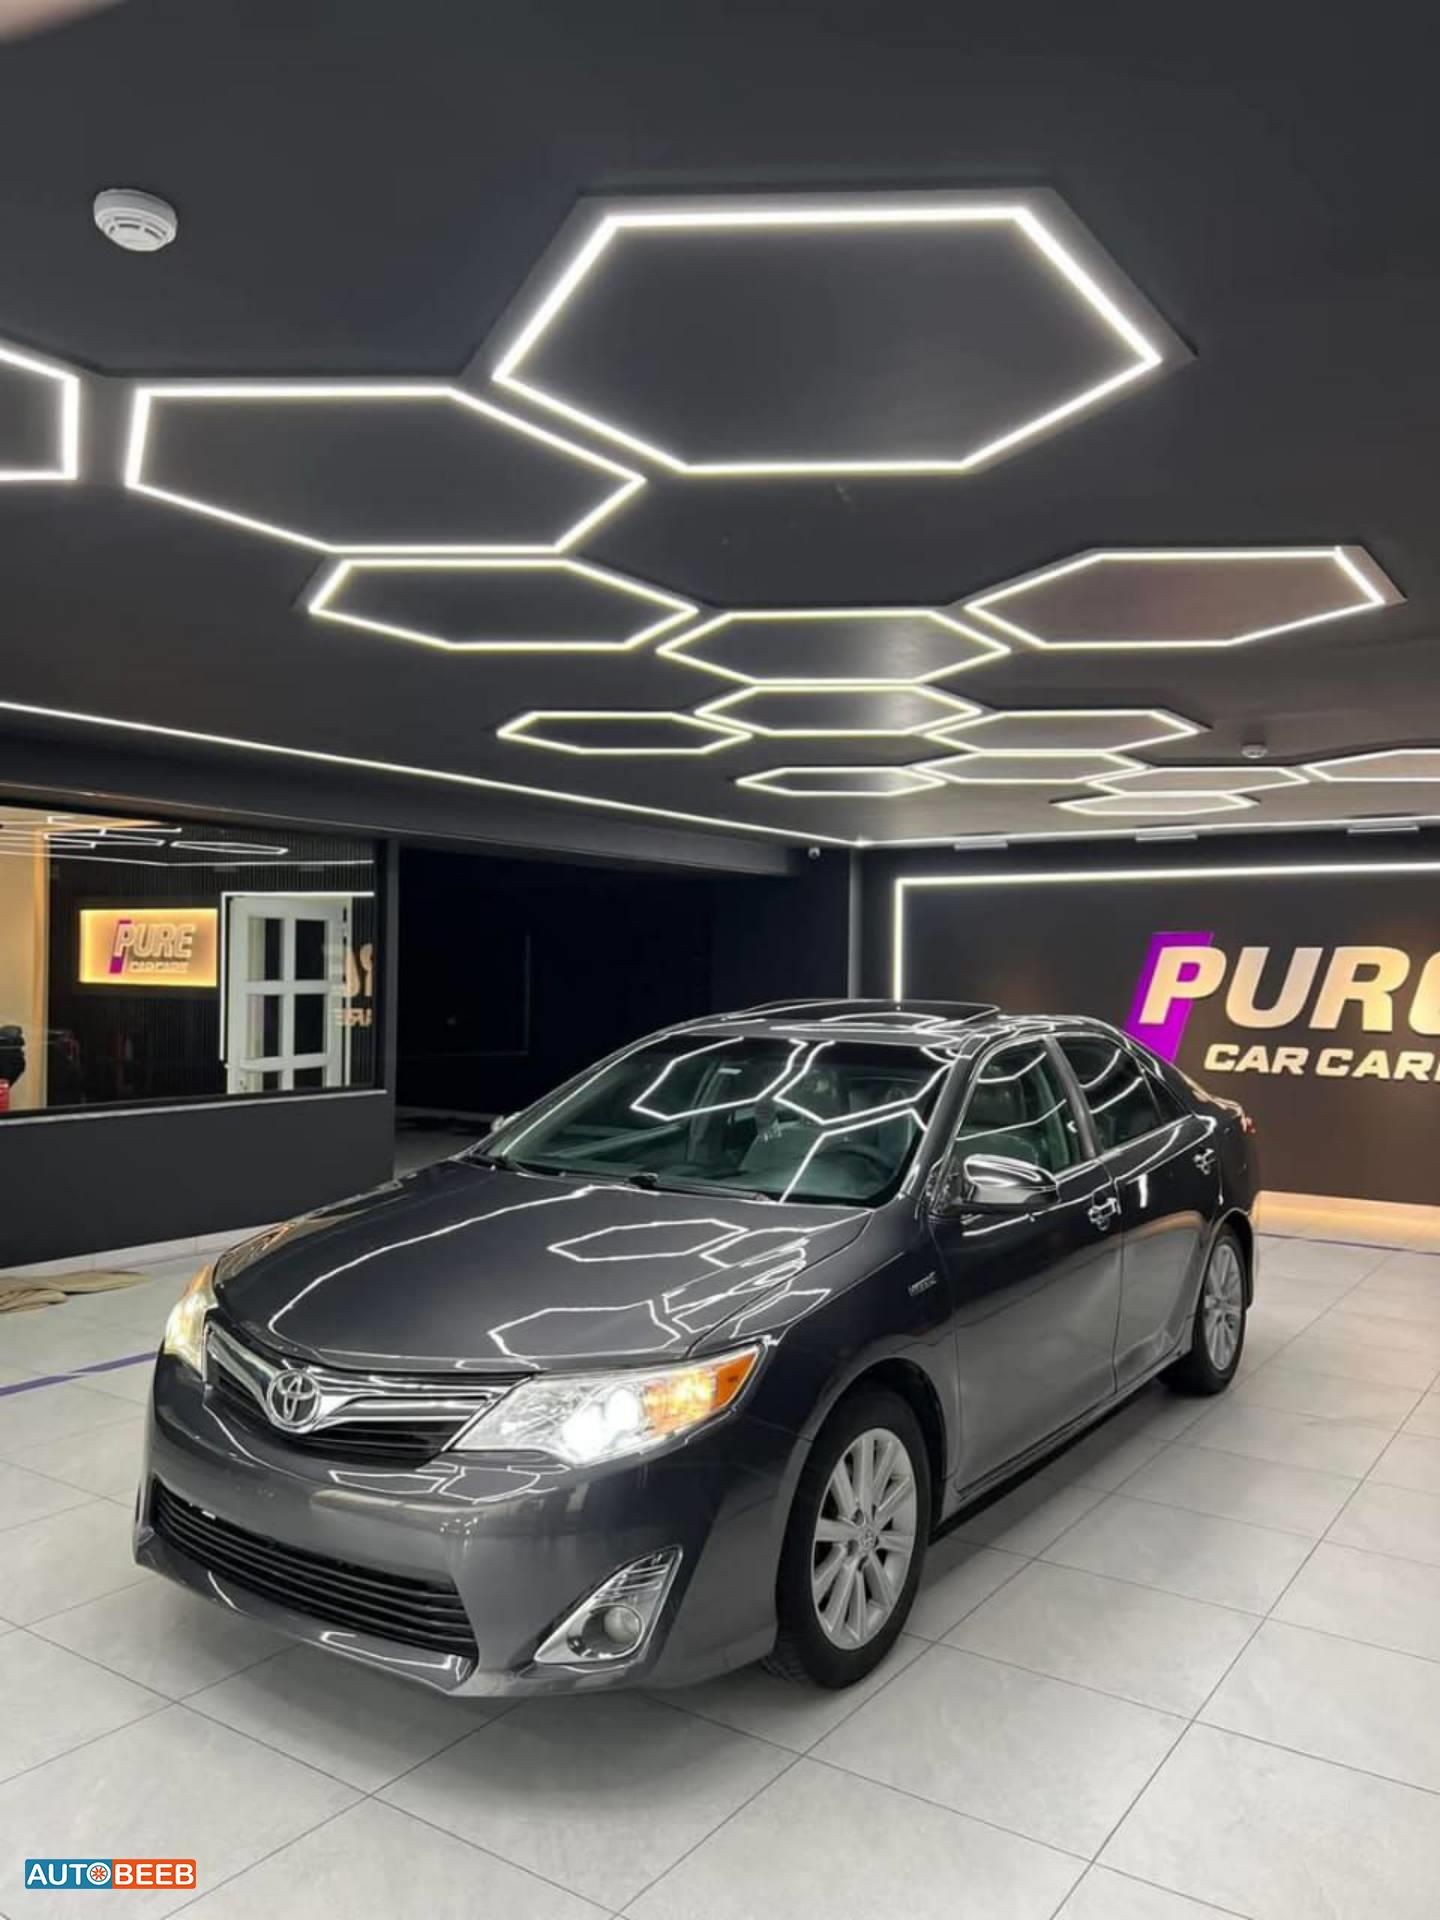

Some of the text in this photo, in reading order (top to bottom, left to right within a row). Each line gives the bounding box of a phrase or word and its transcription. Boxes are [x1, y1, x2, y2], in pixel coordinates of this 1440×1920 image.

[113, 923, 195, 958] PURE
[1204, 1043, 1440, 1083] CAR CAR
